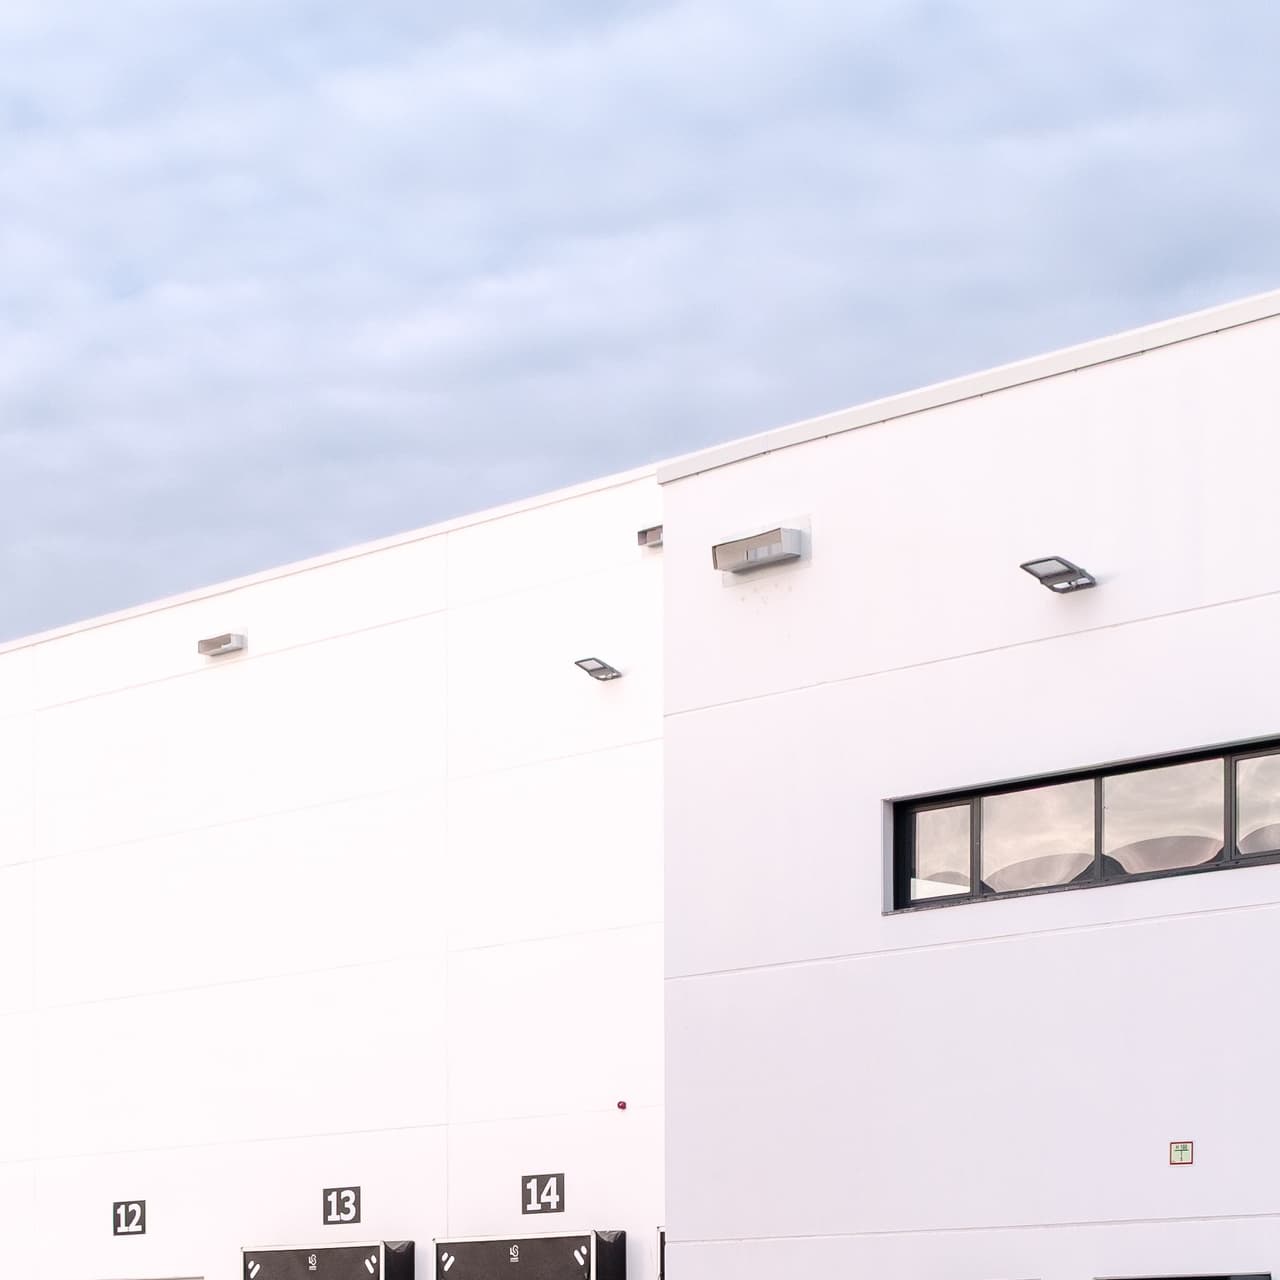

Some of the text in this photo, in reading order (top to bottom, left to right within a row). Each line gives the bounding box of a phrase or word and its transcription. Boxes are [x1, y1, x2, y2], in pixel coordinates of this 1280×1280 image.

[327, 1189, 357, 1222] 13
[526, 1177, 560, 1211] 14
[116, 1203, 143, 1233] 12
